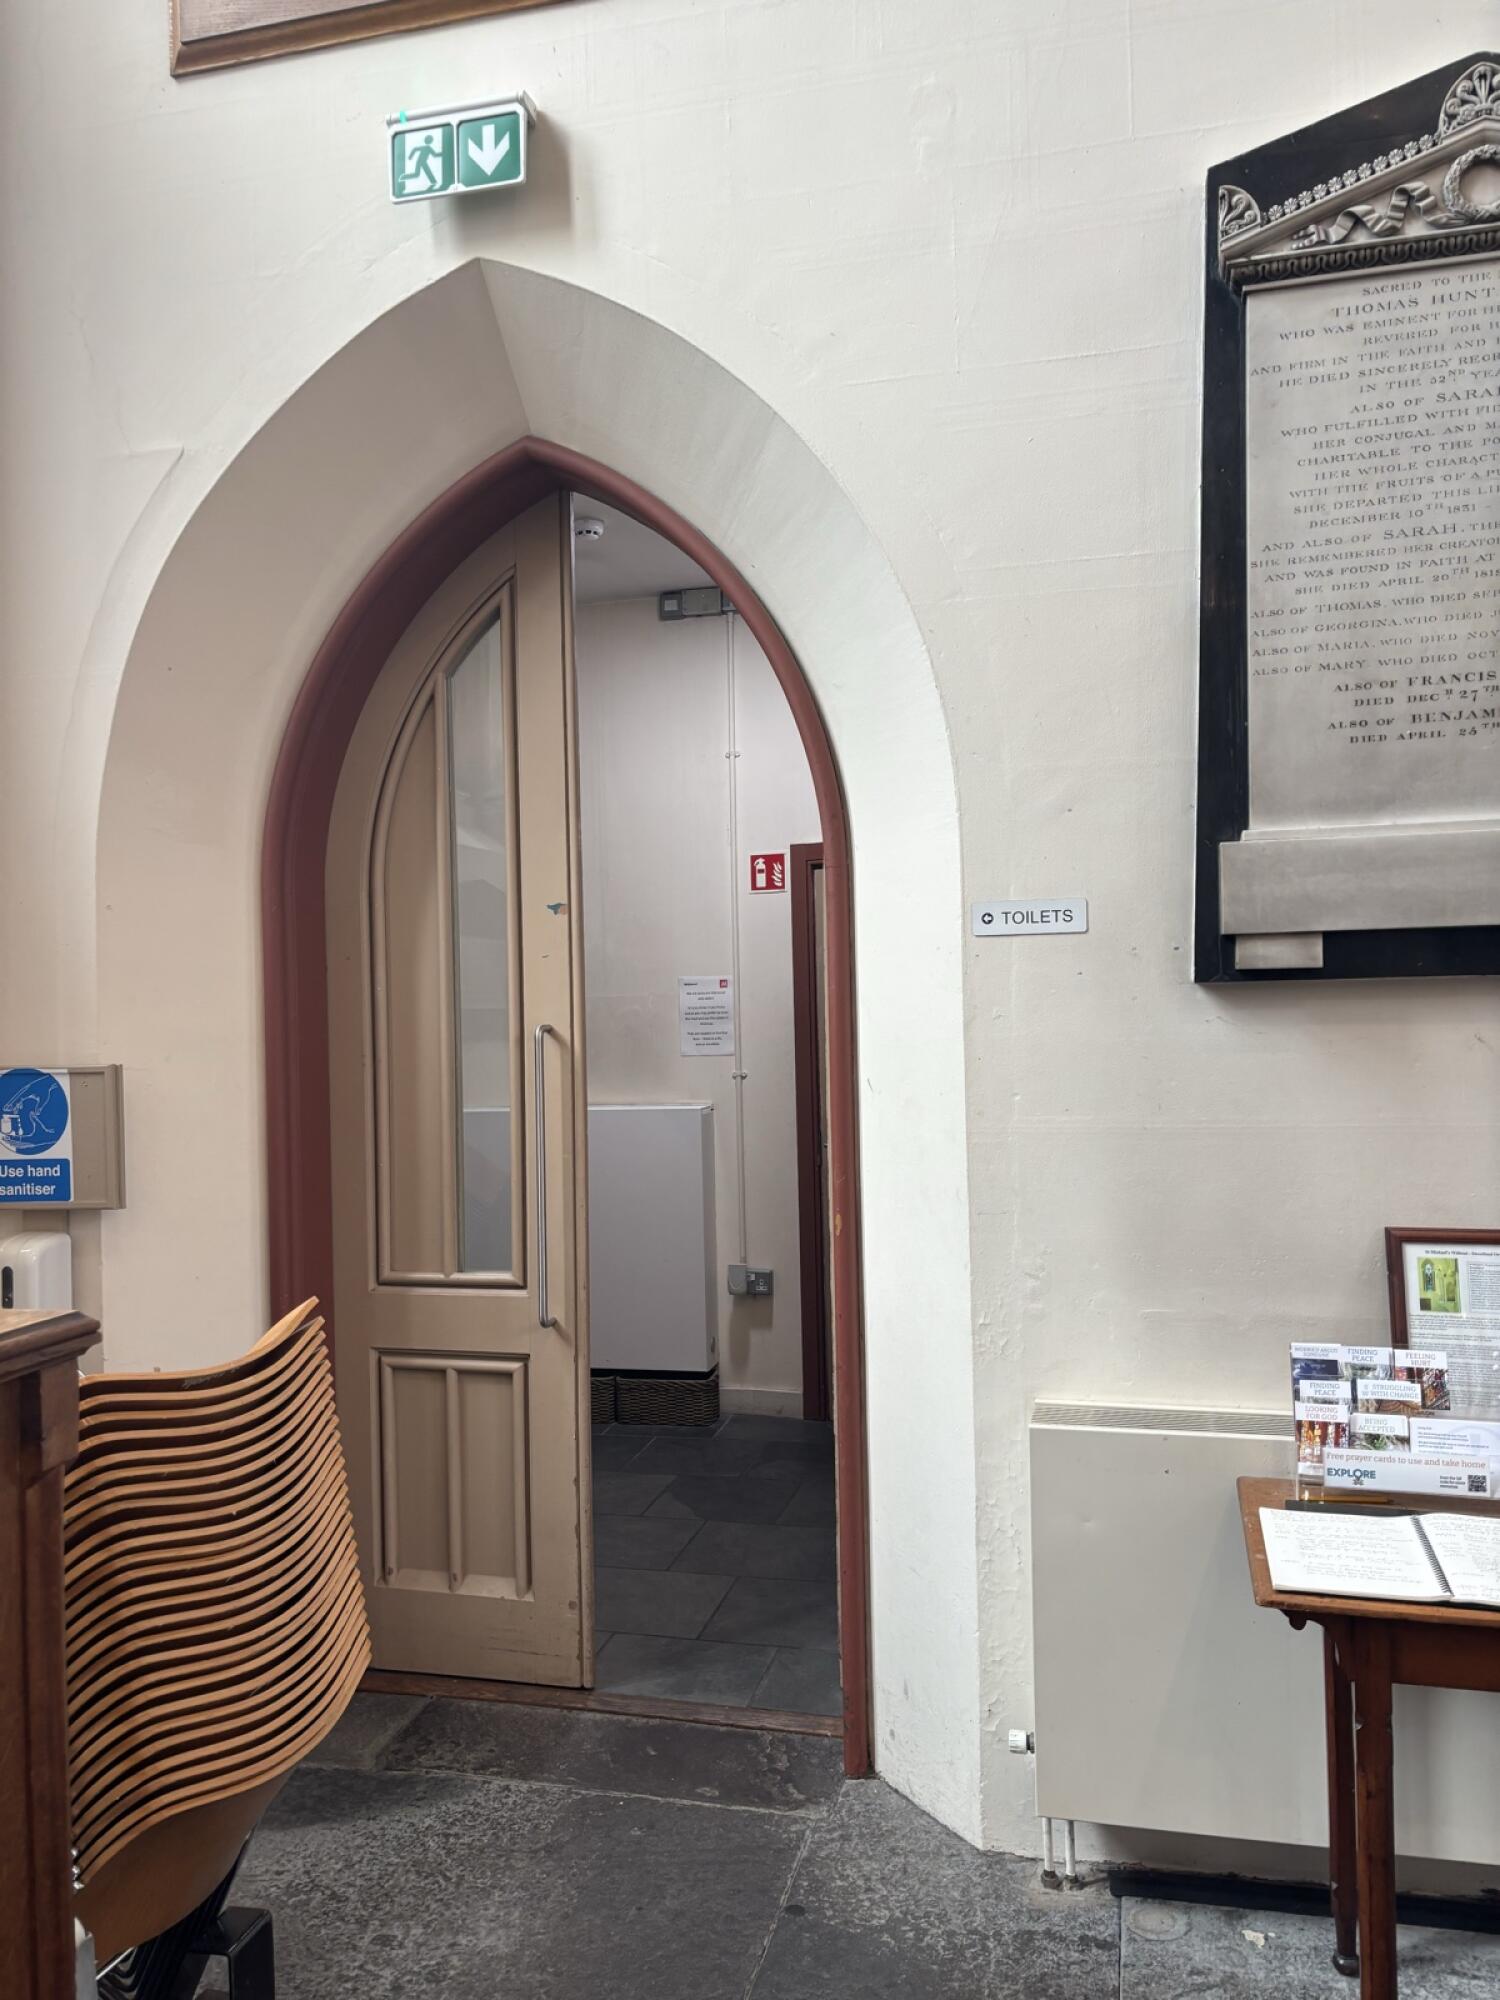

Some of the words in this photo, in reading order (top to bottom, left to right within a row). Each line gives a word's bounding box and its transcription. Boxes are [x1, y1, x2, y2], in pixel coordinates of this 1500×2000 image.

[1362, 280, 1422, 296] SACRED
[1432, 276, 1450, 287] TO
[1458, 271, 1492, 283] THE
[1331, 298, 1419, 317] THOMAS
[1279, 328, 1315, 340] WHO
[1323, 323, 1354, 335] WAS
[1363, 312, 1440, 330] EMINENT
[1448, 308, 1477, 319] FOR
[1363, 329, 1438, 346] REVERED
[1450, 323, 1480, 334] FOR
[1250, 364, 1282, 376] AND
[1289, 359, 1325, 371] FIRM
[1332, 355, 1348, 365] IN
[1357, 350, 1390, 362] THE
[1399, 343, 1446, 358] FAITH
[1454, 338, 1486, 350] AND
[1309, 371, 1350, 384] DIED
[1358, 358, 1452, 378] SINCERELY
[1360, 383, 1376, 394] IN
[1385, 378, 1422, 390] THE
[1350, 400, 1395, 414] ALSO
[1404, 397, 1425, 408] OF
[1436, 385, 1500, 403] SARA
[1281, 425, 1317, 437] WHO
[1324, 414, 1418, 432] FULFILLED
[1425, 407, 1469, 420] WITH
[1312, 438, 1346, 450] HER
[1354, 428, 1435, 445] CONJUGAL
[1443, 423, 1476, 435] AND
[1297, 448, 1401, 467] CHARITABLE
[1410, 444, 1432, 454] TO
[1439, 439, 1473, 451] THE
[1314, 469, 1351, 481] HER
[1358, 462, 1418, 476] WHOLE
[1289, 487, 1327, 499] WITH
[1336, 482, 1369, 494] THE
[1376, 475, 1435, 491] FRUITS
[1440, 471, 1466, 481] OF
[1293, 503, 1326, 515] SHE
[1333, 494, 1422, 511] DEPARTED
[1432, 487, 1471, 499] THIS
[1309, 511, 1401, 528] DECEMBER
[1262, 541, 1295, 552] AND
[1302, 537, 1343, 548] ALSO
[1350, 533, 1372, 543] OF
[1250, 559, 1281, 569] SHE
[1288, 547, 1397, 565] REMEMBERED
[1404, 543, 1433, 553] HER
[1264, 572, 1296, 583] AND
[1304, 568, 1334, 579] WAS
[1340, 563, 1390, 576] FOUND
[1396, 560, 1412, 570] IN
[1419, 555, 1468, 568] FAITH
[1295, 585, 1324, 595] SHE
[1332, 580, 1370, 591] DIED
[1378, 576, 1425, 588] APRIL
[1250, 607, 1285, 619] ALSO
[1289, 605, 1308, 615] OF
[1391, 596, 1425, 606] WHO
[1430, 592, 1466, 603] DIED
[1251, 627, 1286, 638] ALSO
[1290, 625, 1309, 634] OF
[1404, 615, 1437, 625] WHO
[1444, 610, 1482, 622] DIED
[1252, 646, 1289, 657] ALSO
[1293, 645, 1311, 655] OF
[1380, 637, 1413, 646] WHO
[1420, 633, 1458, 644] DIED
[1252, 667, 1289, 677] ALSO
[1294, 664, 1312, 673] OF
[1378, 656, 1413, 667] WHO
[1420, 653, 1458, 664] DIED
[1334, 681, 1373, 693] ALSO
[1379, 679, 1399, 689] OF
[1406, 670, 1497, 687] FRANCIS
[1353, 696, 1394, 707] DIED
[1327, 719, 1369, 730] ALSO
[1376, 717, 1396, 727] OF
[1350, 733, 1388, 744] DIED
[1395, 730, 1447, 742] APRIL
[1001, 909, 1074, 925] TOILETS
[0, 1164, 25, 1178] Use
[27, 1164, 61, 1177] hand
[0, 1182, 56, 1196] sanitiser
[1405, 1352, 1436, 1360] FEELING
[1371, 1383, 1417, 1393] STRUGGLING
[1389, 1391, 1419, 1399] CHANGE
[1304, 1405, 1339, 1413] LOOKING
[1322, 1413, 1338, 1421] GOD
[1358, 1424, 1396, 1433] ACCEPTED
[1327, 1452, 1345, 1460] Free
[1345, 1454, 1371, 1463] prayer
[1373, 1455, 1396, 1464] cards
[1398, 1456, 1406, 1464] to
[1424, 1457, 1440, 1466] and
[1441, 1458, 1459, 1467] take
[1461, 1459, 1486, 1468] home
[1327, 1467, 1376, 1479] EXPLORE
